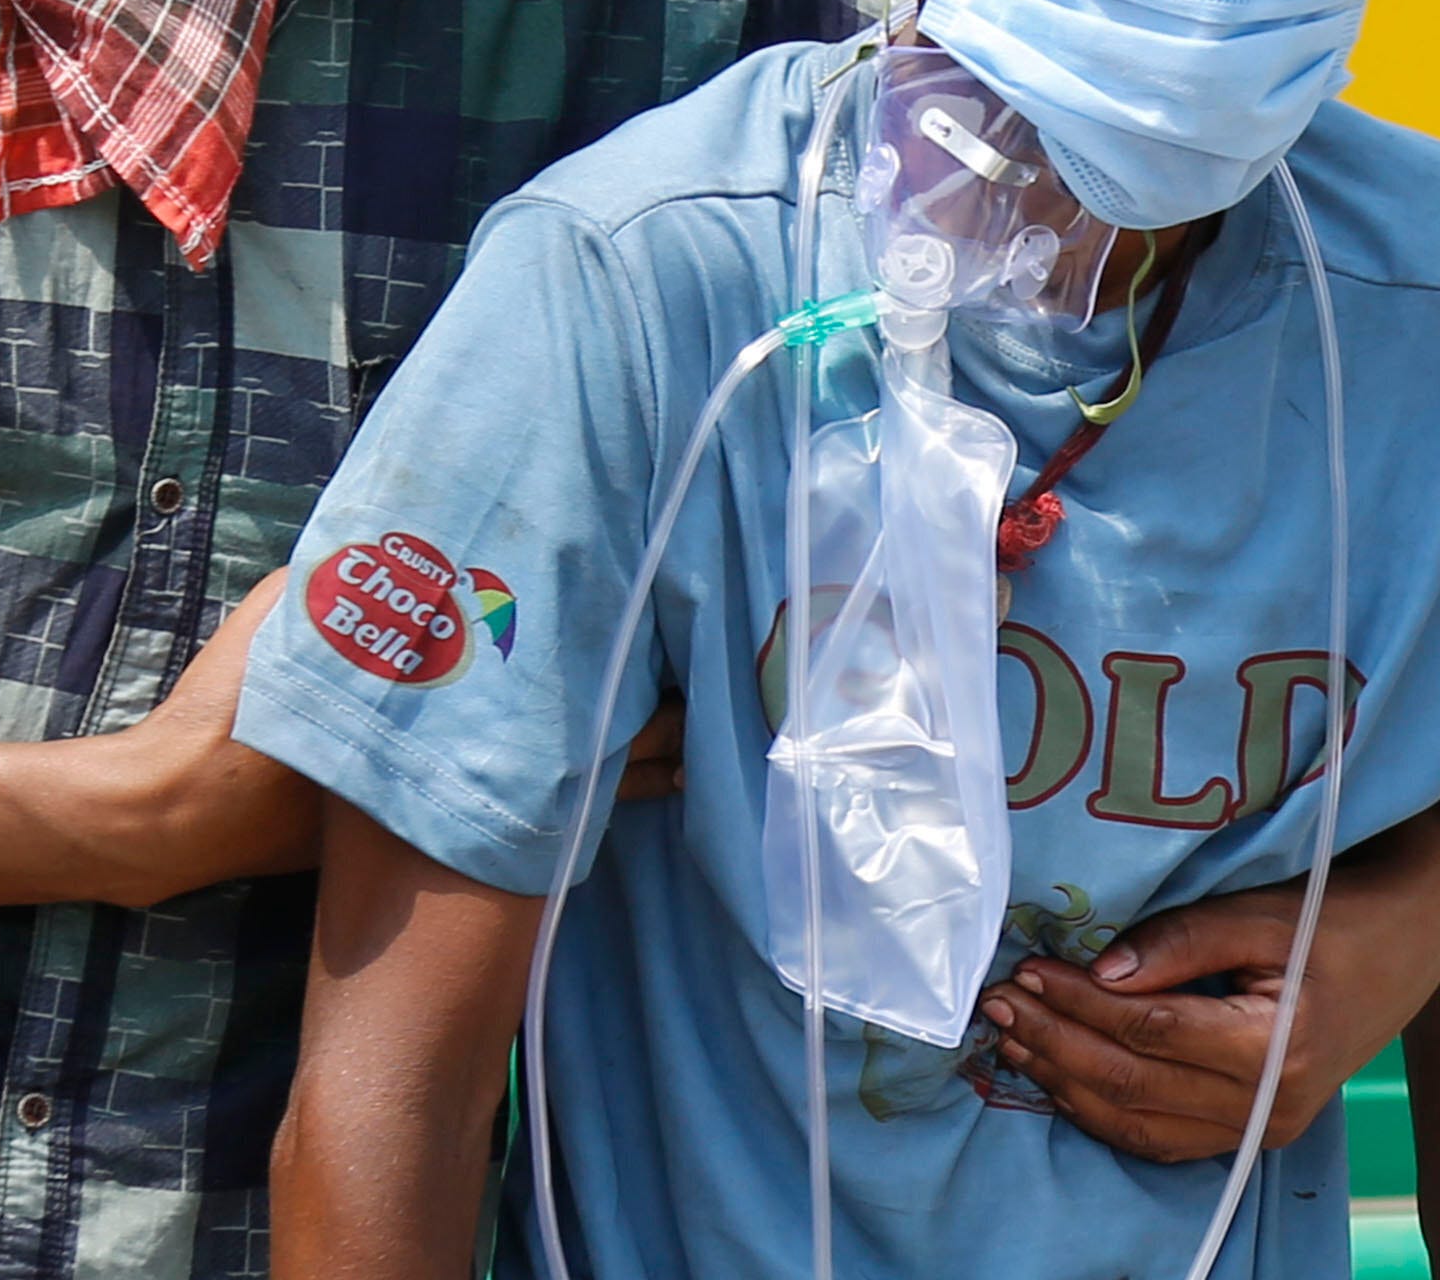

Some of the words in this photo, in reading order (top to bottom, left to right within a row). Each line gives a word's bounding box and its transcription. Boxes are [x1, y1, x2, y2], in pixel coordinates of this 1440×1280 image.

[336, 548, 457, 640] Choco
[383, 536, 457, 587] CRUSTY
[322, 596, 424, 676] Bella
